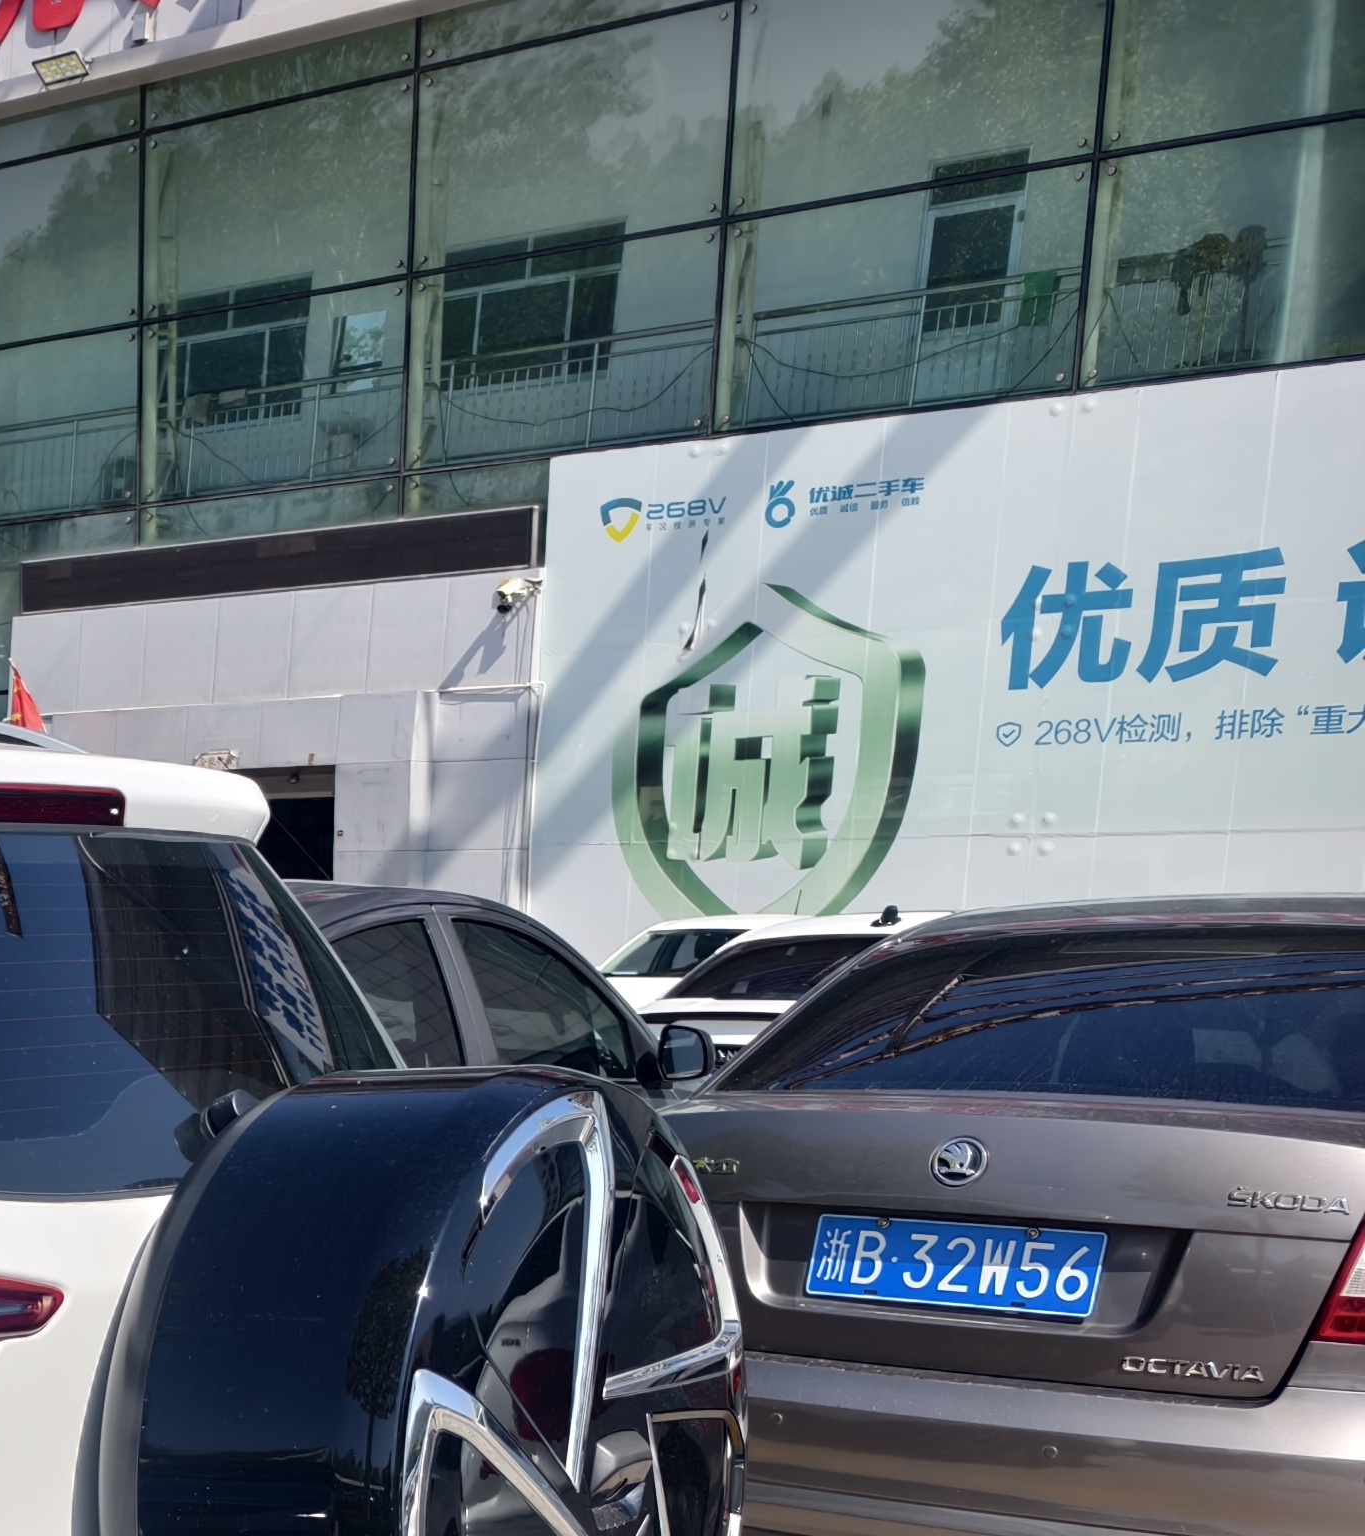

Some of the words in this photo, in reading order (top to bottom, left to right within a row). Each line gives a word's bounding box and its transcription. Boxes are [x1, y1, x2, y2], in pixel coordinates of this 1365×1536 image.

[809, 477, 925, 504] 优诚二手车
[645, 496, 727, 521] 268V
[1000, 546, 1287, 691] 优质
[1121, 1356, 1264, 1384] OCTAVIA
